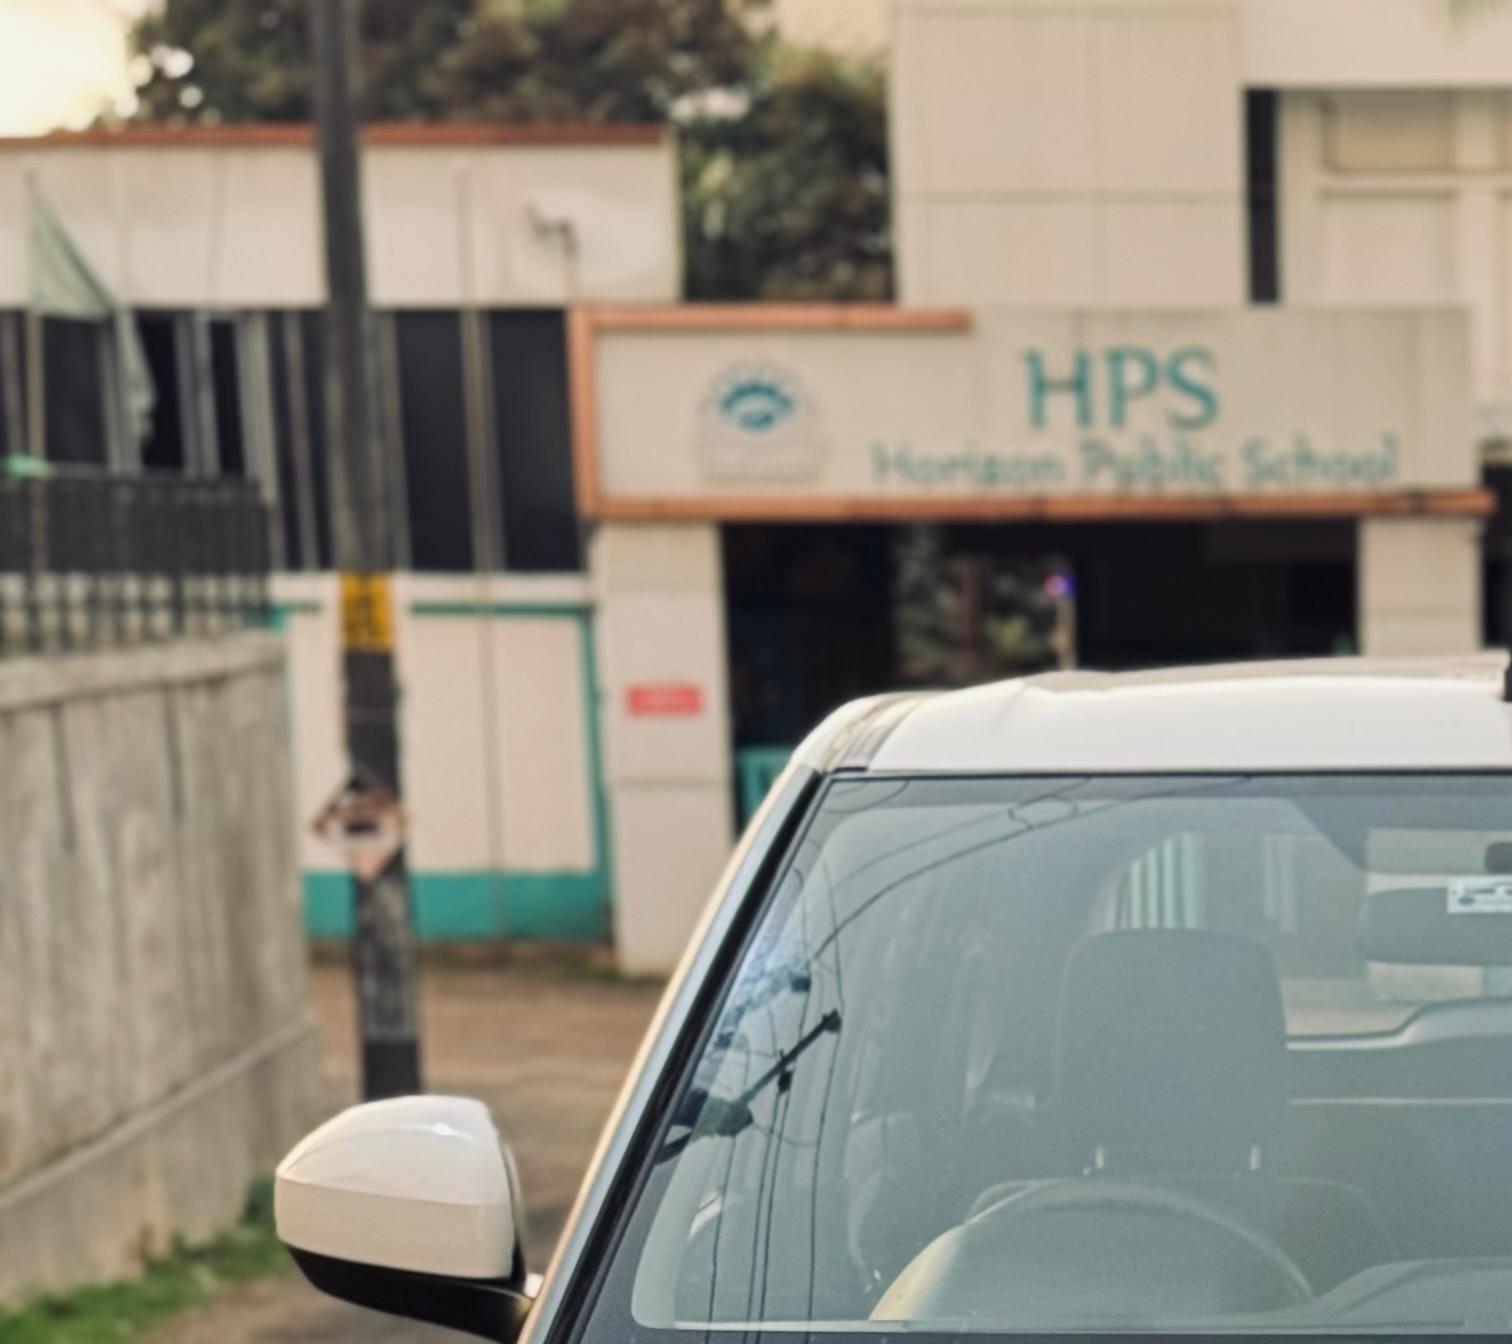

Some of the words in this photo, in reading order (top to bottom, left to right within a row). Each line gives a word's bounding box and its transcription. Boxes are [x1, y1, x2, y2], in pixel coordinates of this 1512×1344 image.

[1024, 345, 1220, 430] HPS
[870, 441, 1066, 487] Horizon
[1079, 438, 1225, 489] Public
[1240, 434, 1398, 486] School
